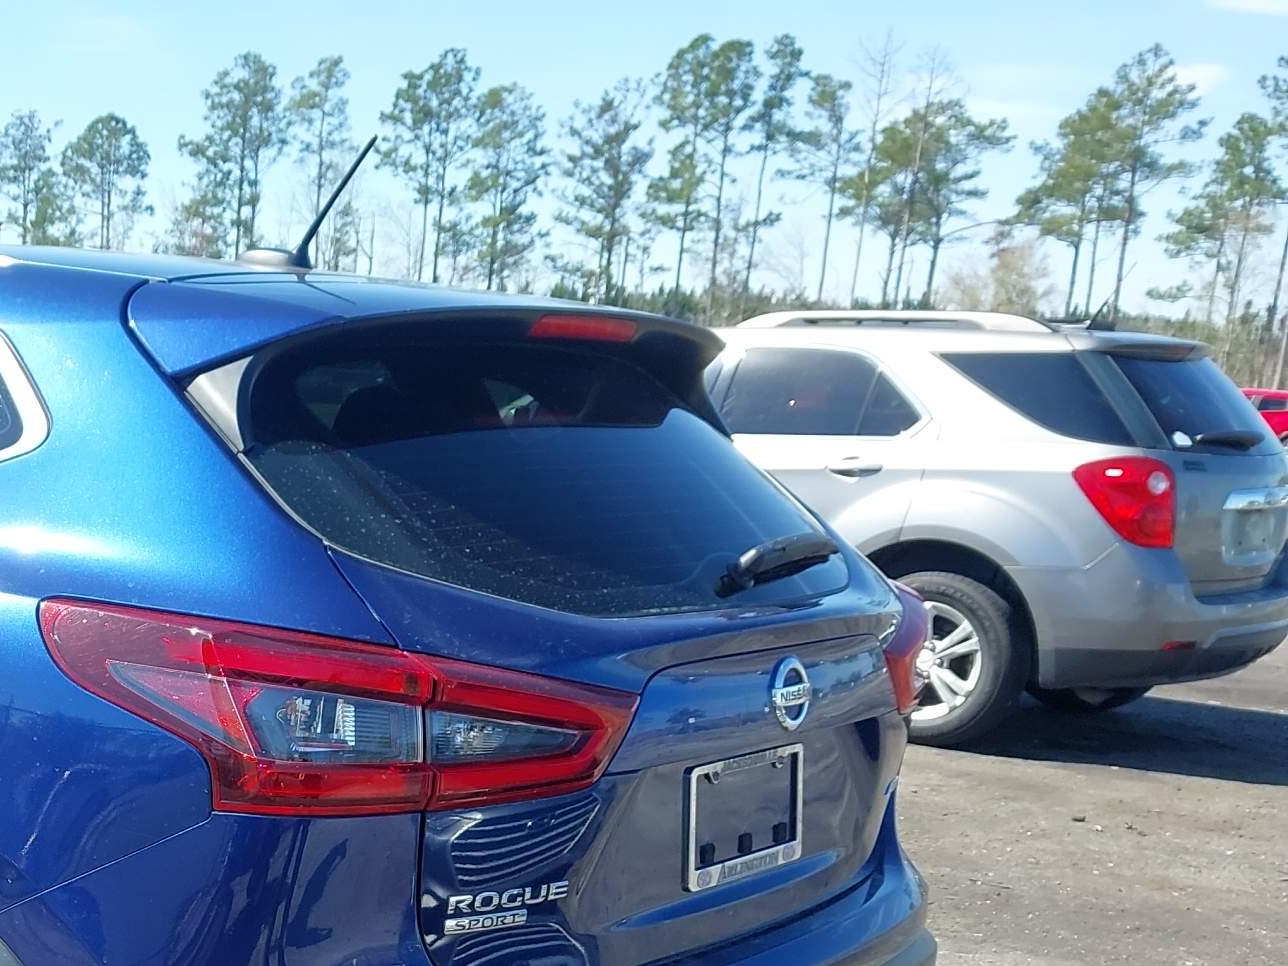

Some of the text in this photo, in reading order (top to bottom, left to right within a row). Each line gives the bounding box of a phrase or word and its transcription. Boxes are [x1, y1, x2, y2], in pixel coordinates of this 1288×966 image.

[780, 685, 810, 703] NISSA
[447, 880, 569, 914] ROGUE
[454, 912, 523, 931] SPORT
